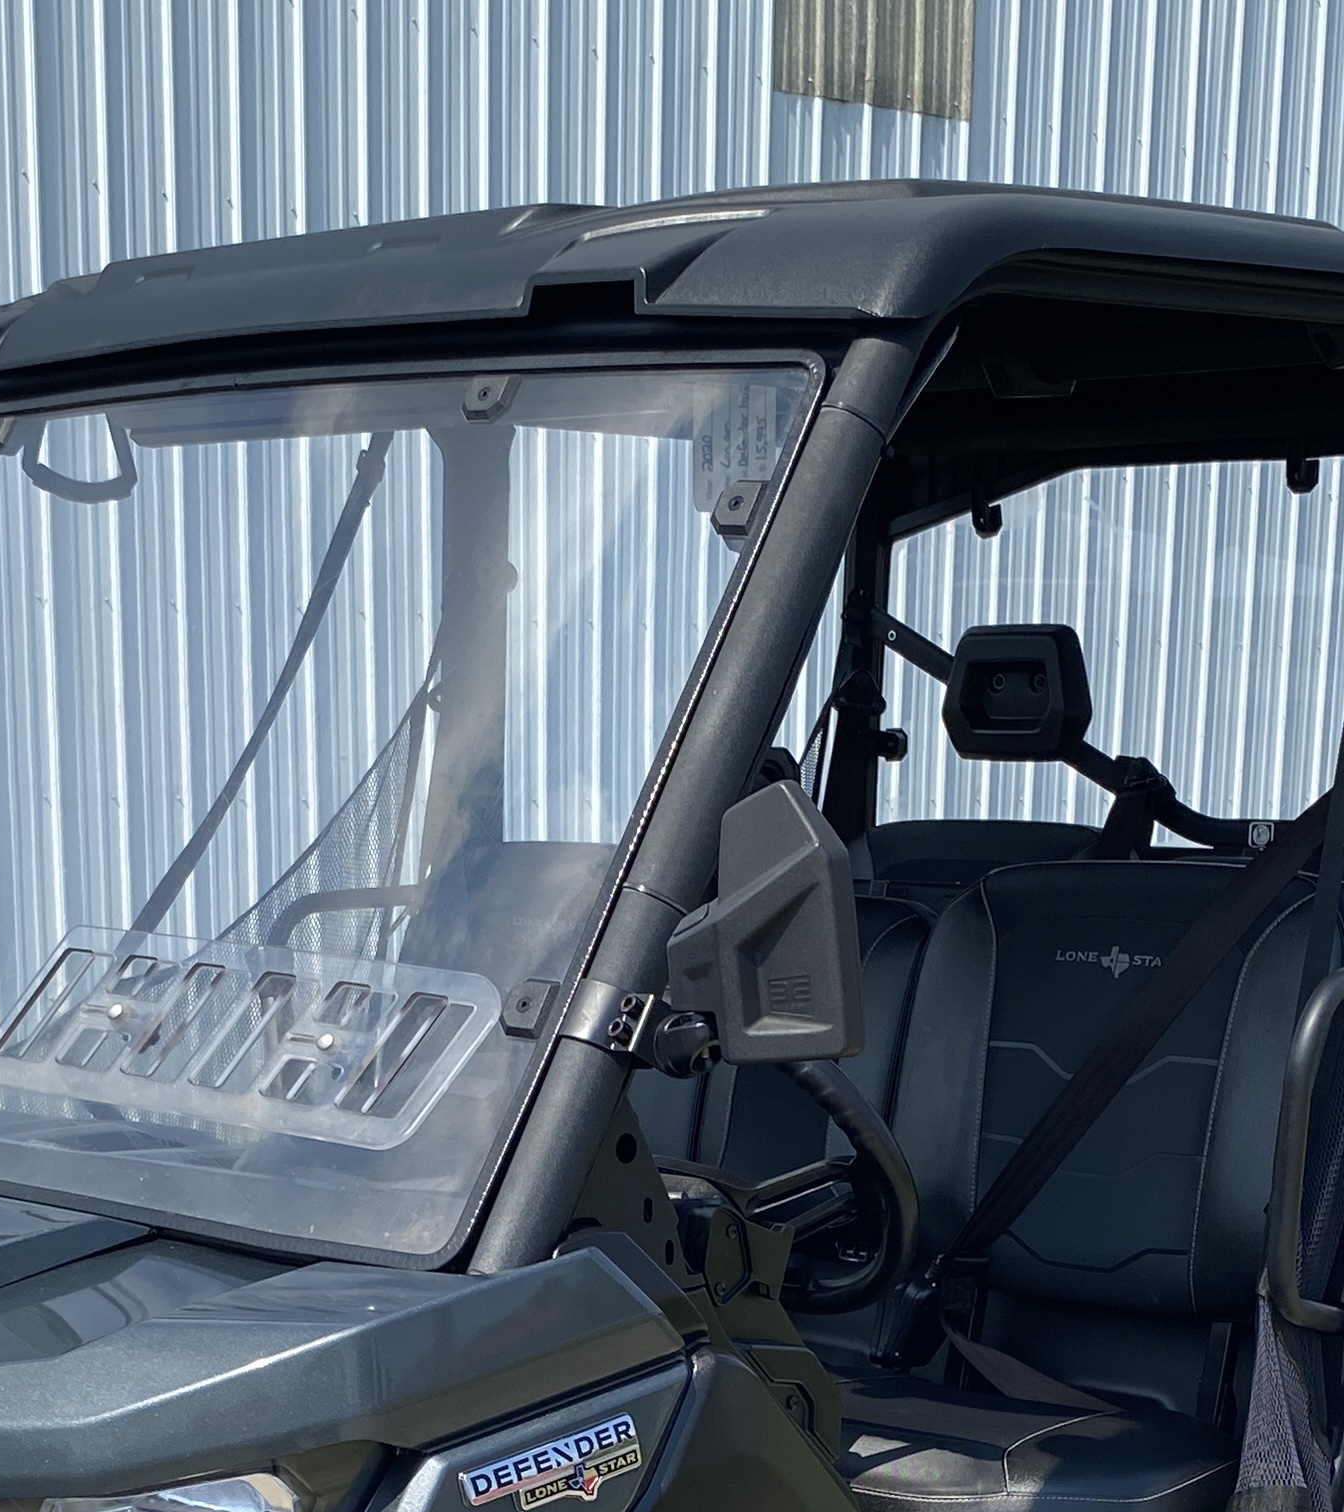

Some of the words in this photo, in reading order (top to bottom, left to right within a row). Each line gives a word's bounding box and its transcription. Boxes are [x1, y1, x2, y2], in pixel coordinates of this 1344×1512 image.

[701, 434, 713, 472] 2020
[1056, 950, 1099, 962] LONE
[1132, 955, 1162, 967] STA
[470, 1420, 634, 1497] DEFENDER
[525, 1478, 568, 1503] LONE
[598, 1451, 638, 1475] STAR
